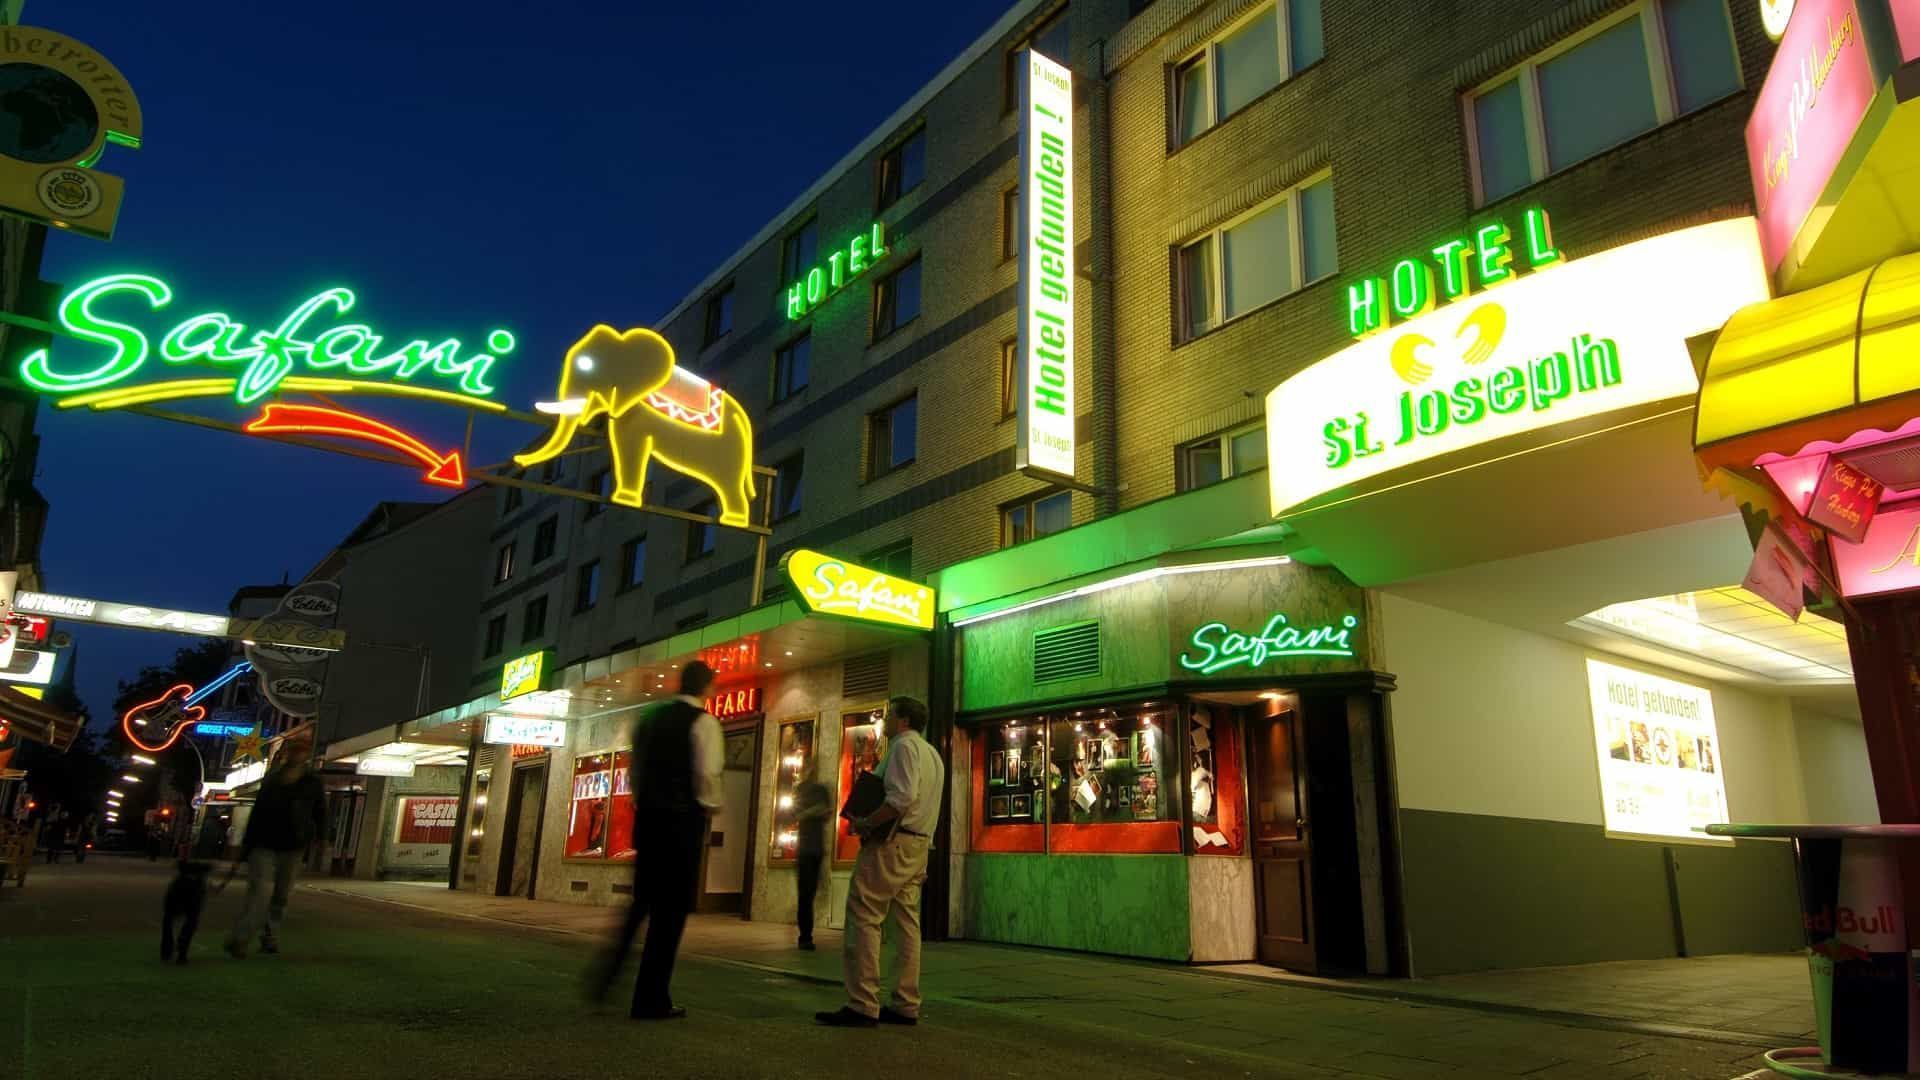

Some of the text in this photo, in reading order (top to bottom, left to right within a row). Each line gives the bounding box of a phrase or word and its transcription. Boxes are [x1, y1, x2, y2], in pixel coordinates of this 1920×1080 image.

[2, 30, 130, 130] betrotter
[1034, 131, 1069, 304] gefunden
[787, 221, 886, 320] HOTEL
[1347, 208, 1563, 341] HOTEL
[20, 273, 515, 404] Safari
[1034, 310, 1066, 416] Hotel
[1394, 332, 1623, 446] Joseph
[118, 606, 329, 644] CASINO
[806, 561, 927, 617] Safari
[1181, 614, 1361, 670] Safari
[703, 688, 756, 717] AFARI
[1607, 680, 1640, 708] Hotel
[414, 803, 458, 819] CASIN
[1838, 905, 1896, 934] Bull
